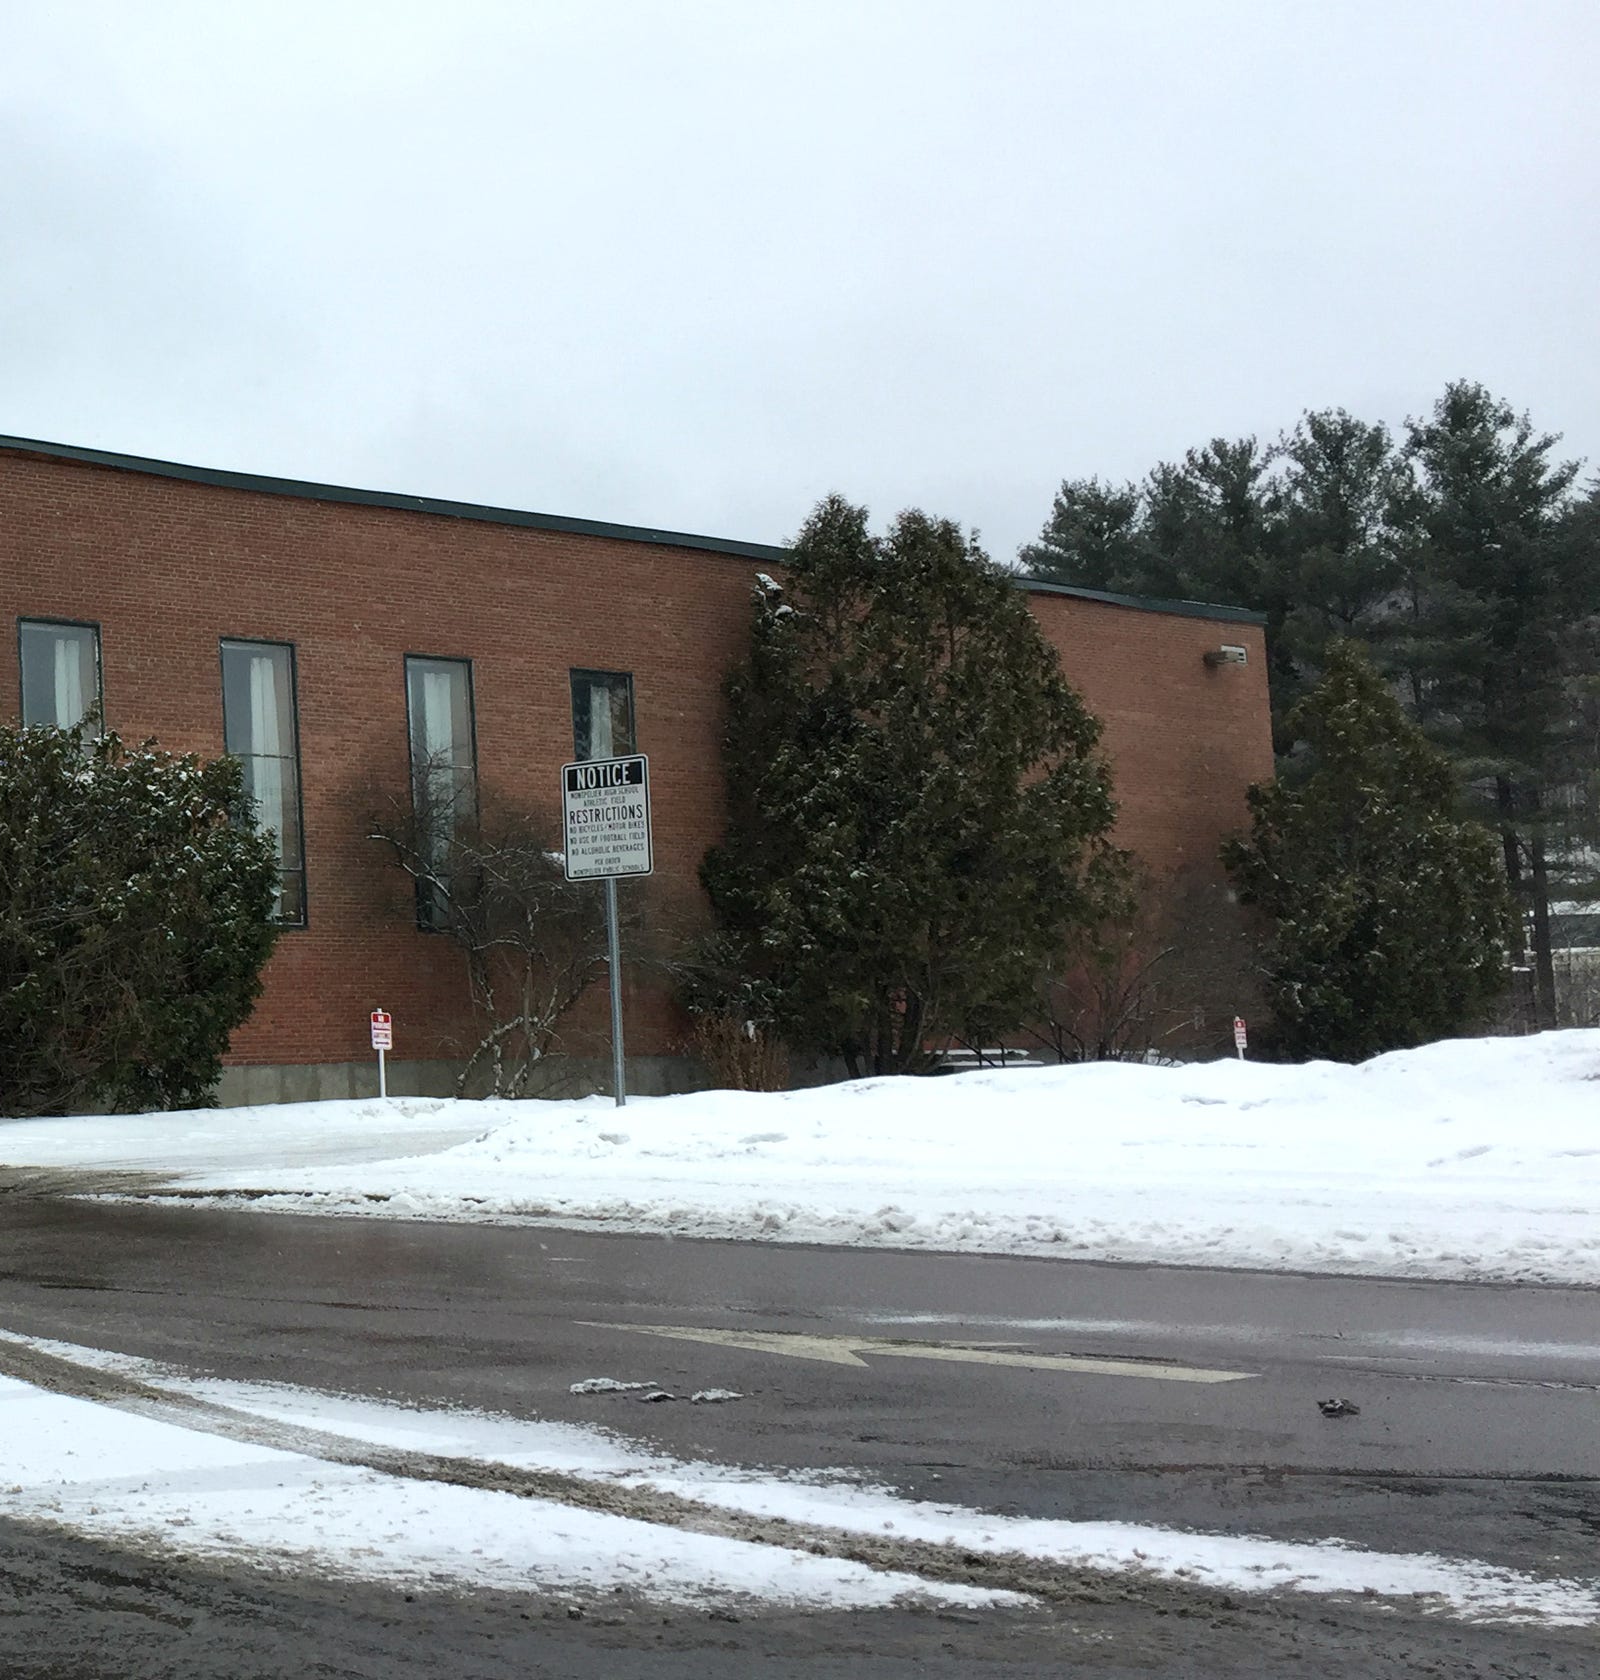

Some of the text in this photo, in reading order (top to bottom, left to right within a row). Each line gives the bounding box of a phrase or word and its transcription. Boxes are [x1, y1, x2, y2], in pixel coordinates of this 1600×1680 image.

[576, 763, 631, 789] NOTICE
[569, 804, 643, 824] RESTRICTIONS
[581, 846, 611, 855] ALCOHOLIC
[613, 843, 644, 853] BEVERAGES
